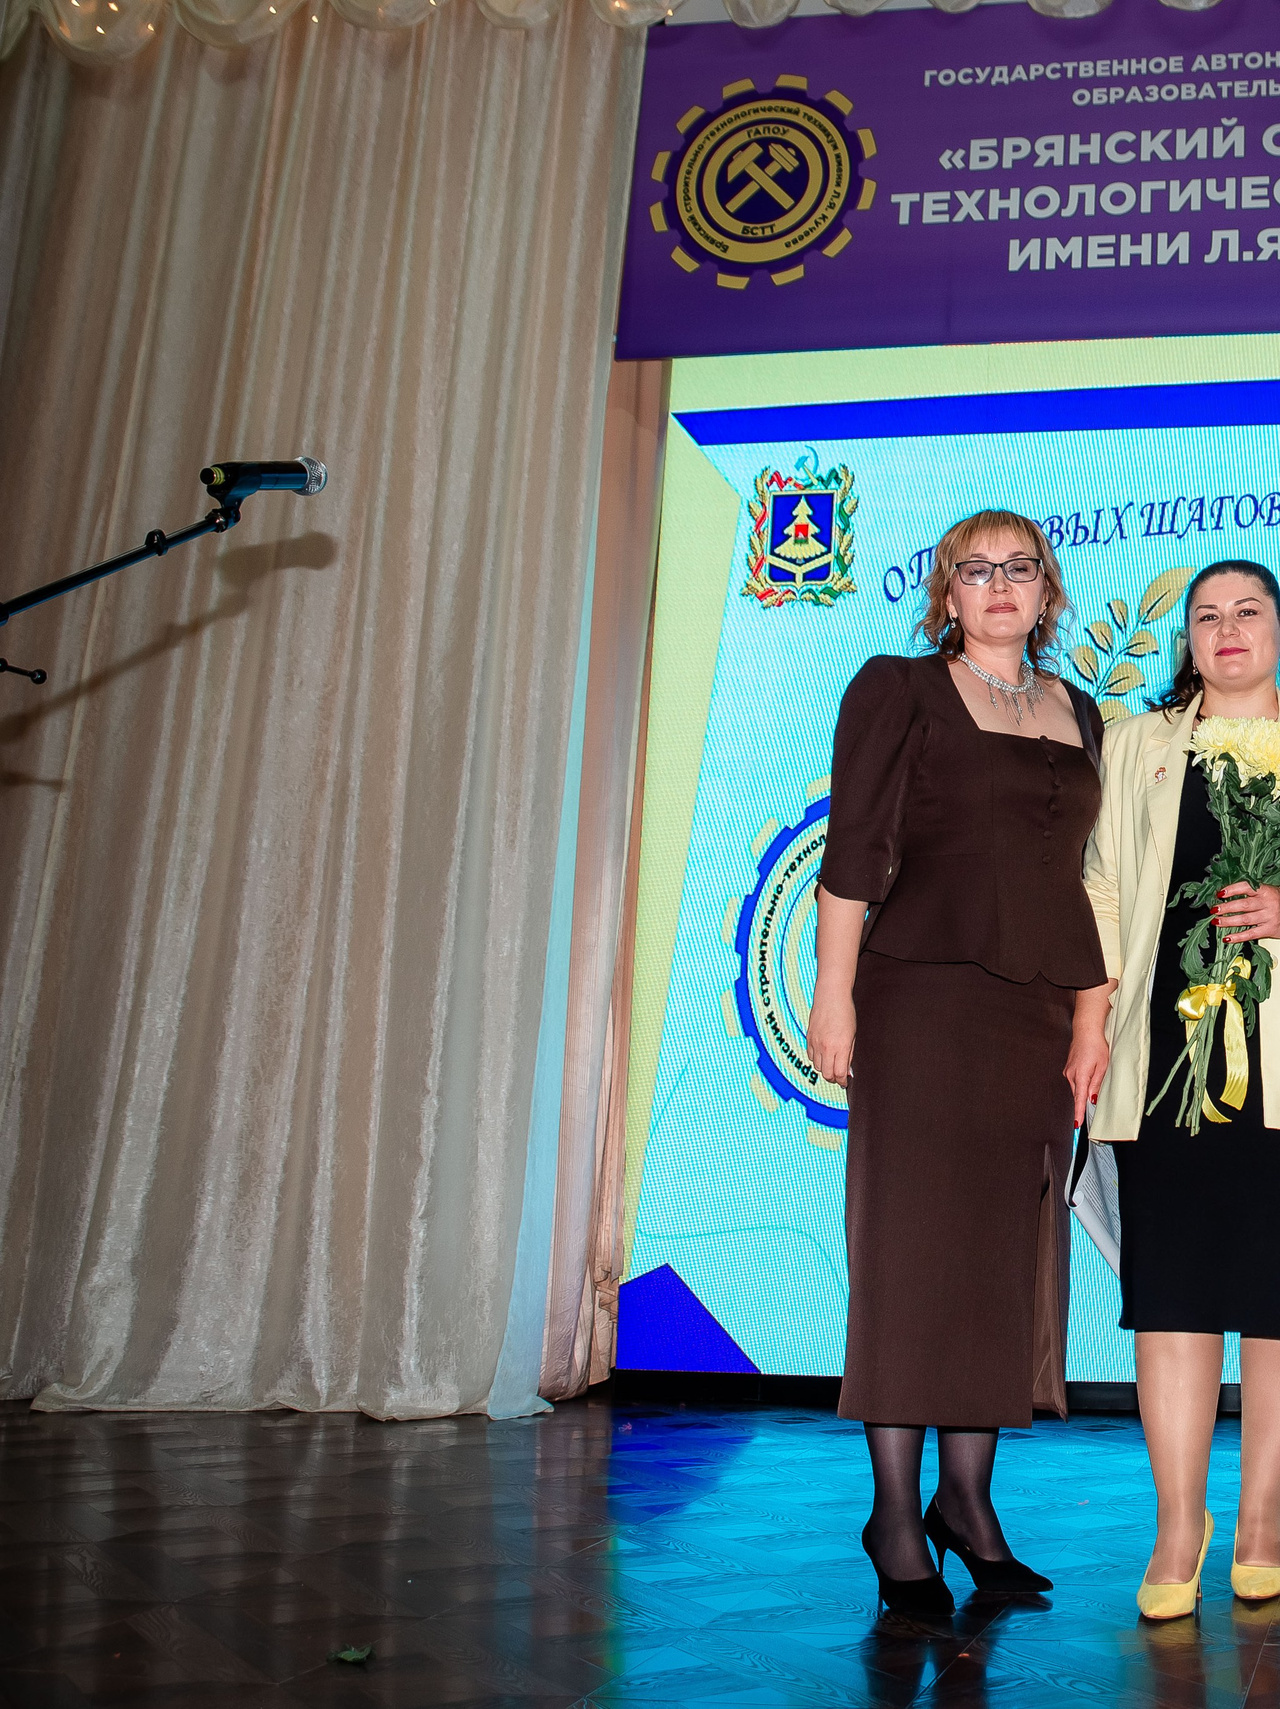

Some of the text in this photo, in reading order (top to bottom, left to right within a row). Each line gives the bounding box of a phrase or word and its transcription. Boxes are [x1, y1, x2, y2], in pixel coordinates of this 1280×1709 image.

[923, 55, 1185, 88] ГОСУДАРСТВЕННОЕ
[746, 125, 790, 139] ГАПОУ
[802, 111, 840, 152] техникум
[938, 117, 1246, 172] «БРЯНСКИЙ
[682, 105, 801, 214] строительно-технологический
[834, 152, 844, 188] имени
[687, 214, 730, 254] Брянский
[740, 223, 777, 237] БСТТ
[784, 213, 829, 249] Кучеева
[1008, 231, 1191, 273] ИМЕНИ
[758, 833, 827, 1086] Брянский строительно-технол
